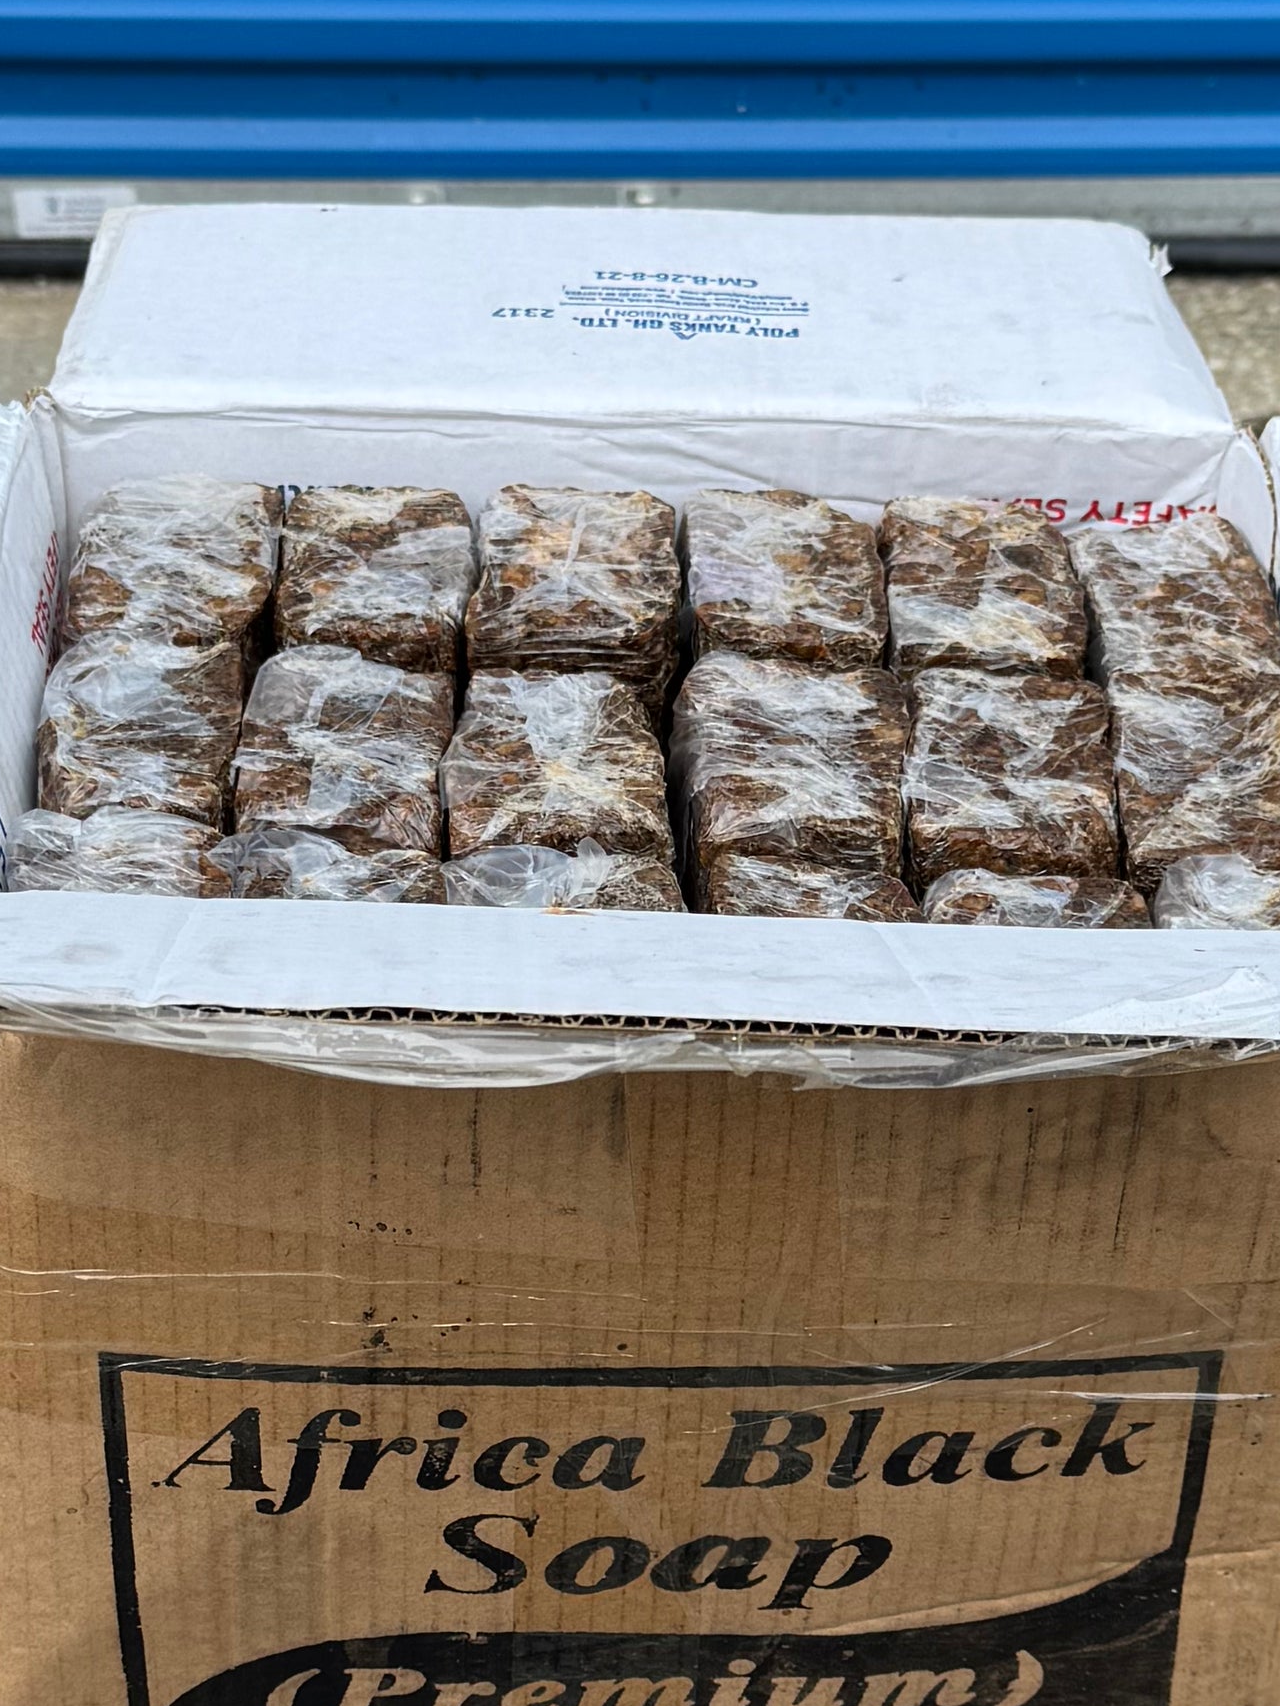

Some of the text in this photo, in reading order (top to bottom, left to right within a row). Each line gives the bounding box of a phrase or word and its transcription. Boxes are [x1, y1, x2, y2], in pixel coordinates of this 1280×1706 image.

[492, 307, 555, 318] 2317
[572, 316, 619, 328] LTD.
[669, 321, 740, 333] TANKS
[745, 326, 800, 338] POLY
[165, 1398, 1156, 1516] Africa Black
[423, 1511, 896, 1612] Soap
